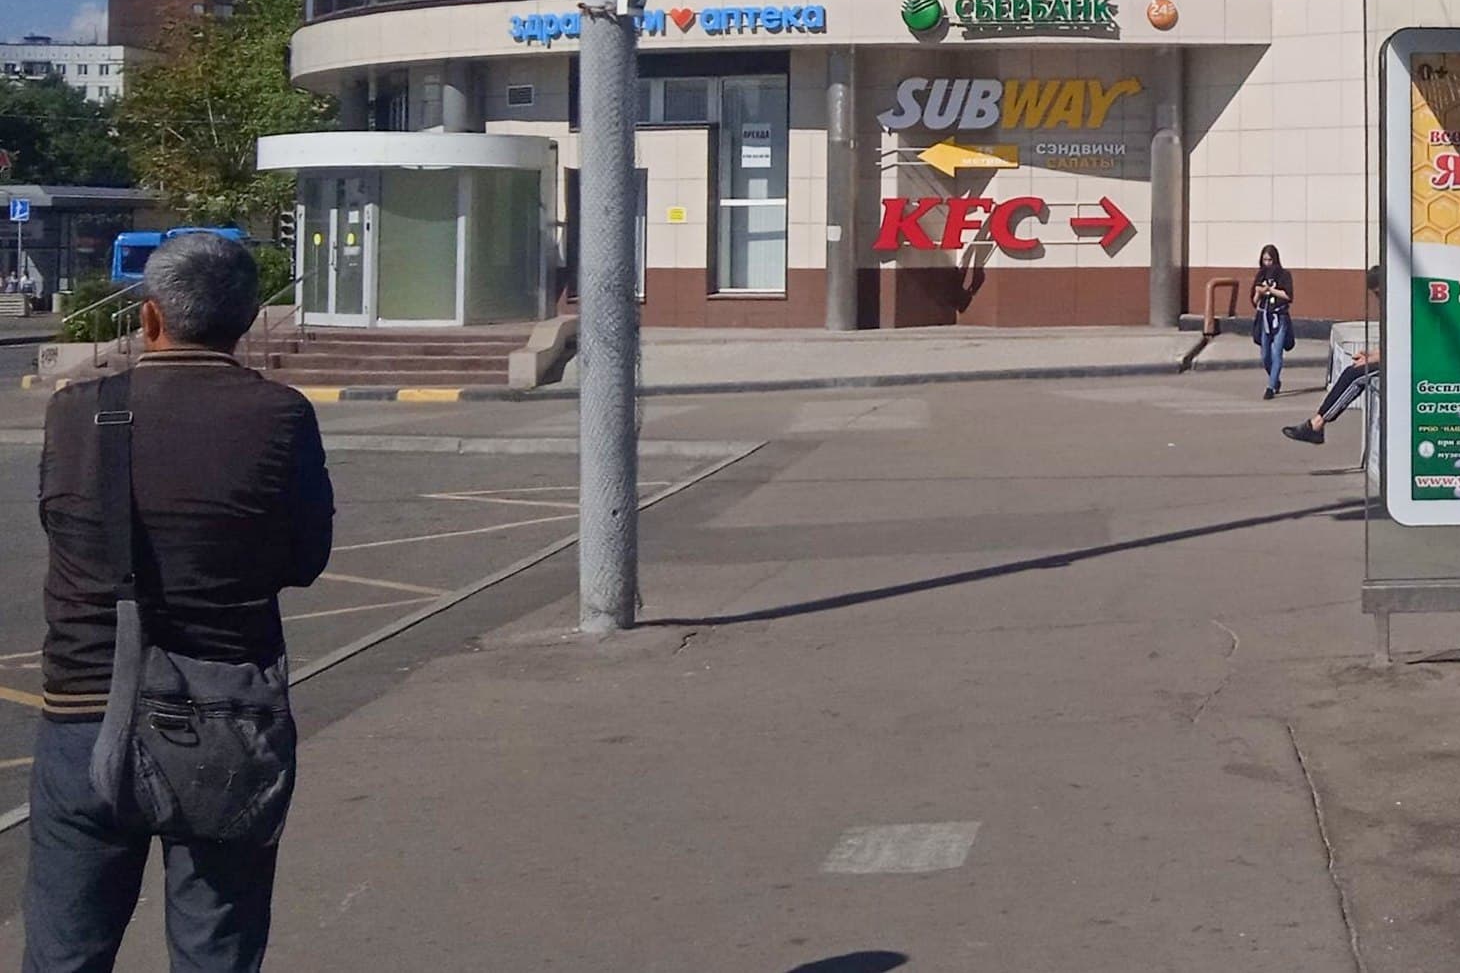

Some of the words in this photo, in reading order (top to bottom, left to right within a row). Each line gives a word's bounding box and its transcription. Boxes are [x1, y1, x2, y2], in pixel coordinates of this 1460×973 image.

[508, 7, 665, 46] здраи
[702, 4, 826, 33] аптека
[877, 77, 1142, 133] SUBWAY
[1036, 143, 1126, 157] СЭНДВИЧИ
[1047, 158, 1115, 169] САЛАТЫ
[872, 196, 1046, 251] KFC
[1429, 281, 1449, 303] в
[1417, 402, 1434, 413] от
